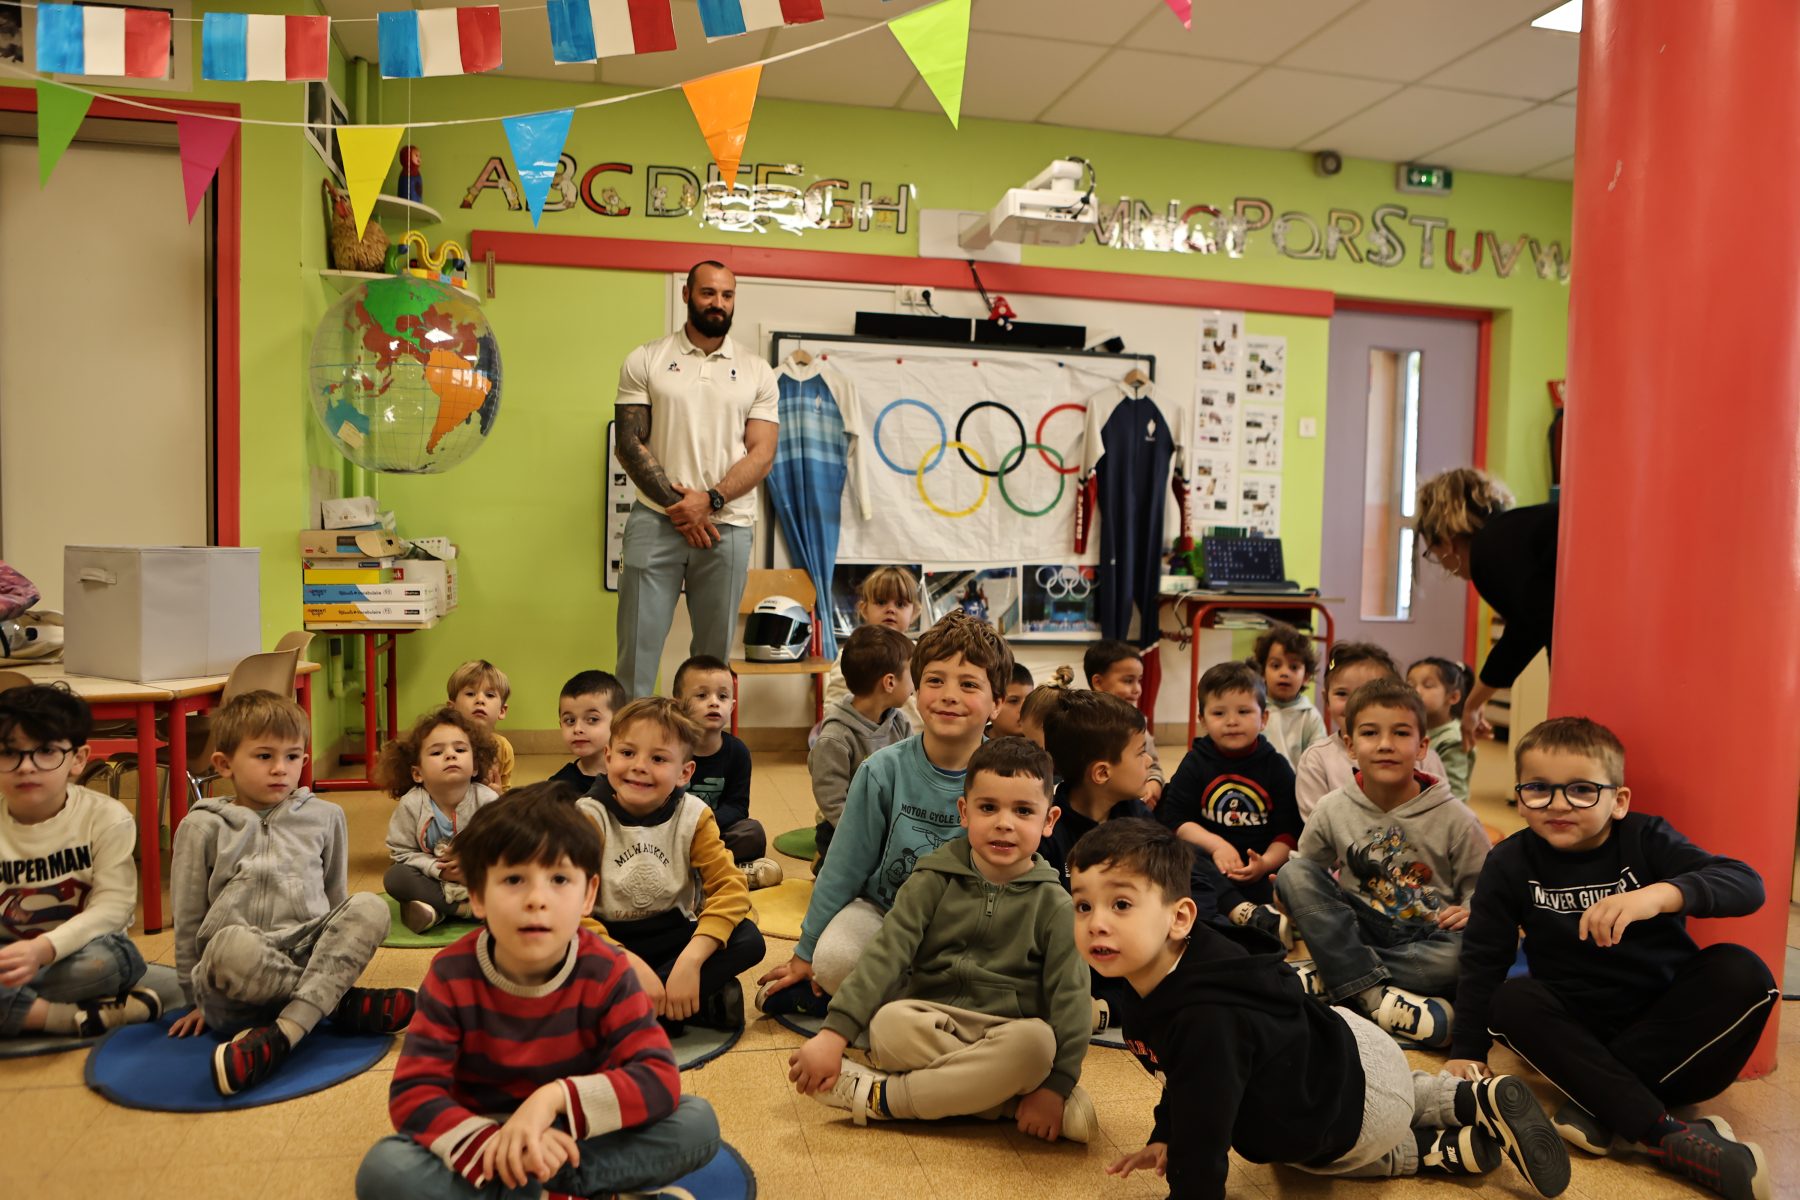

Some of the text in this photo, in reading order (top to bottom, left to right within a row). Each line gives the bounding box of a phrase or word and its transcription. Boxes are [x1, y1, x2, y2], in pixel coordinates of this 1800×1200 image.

[901, 803, 927, 819] MOTOR
[929, 811, 958, 824] CYCLE
[0, 845, 92, 885] UPERMAN
[614, 842, 670, 868] MILWAUKEE
[1534, 885, 1578, 910] NEVER
[1446, 1145, 1459, 1164] NIKE
